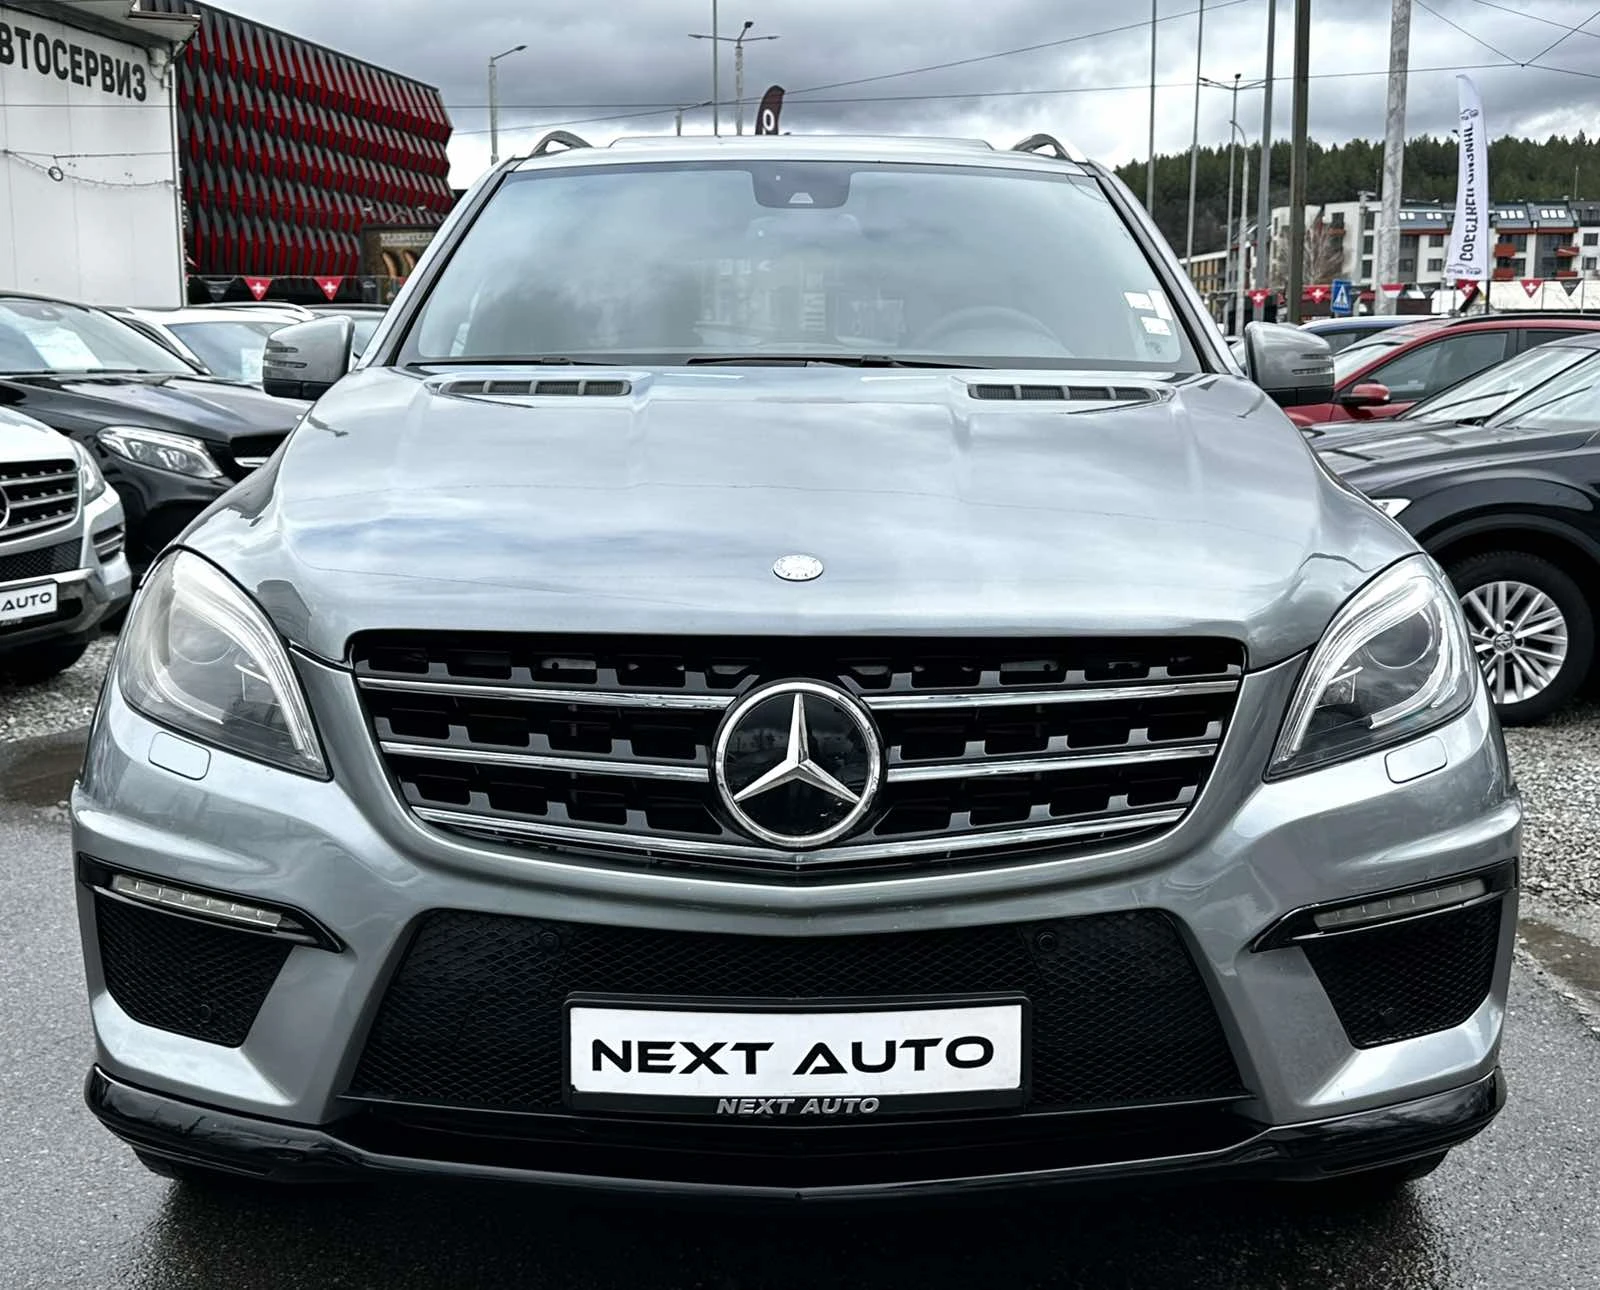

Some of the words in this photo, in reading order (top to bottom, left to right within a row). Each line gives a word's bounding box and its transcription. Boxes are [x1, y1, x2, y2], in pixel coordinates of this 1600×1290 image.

[1, 592, 51, 612] AUTO
[592, 1039, 774, 1075] NEXT
[792, 1036, 994, 1075] AUTO
[716, 1098, 796, 1115] NEXT
[799, 1097, 880, 1115] AUTO
